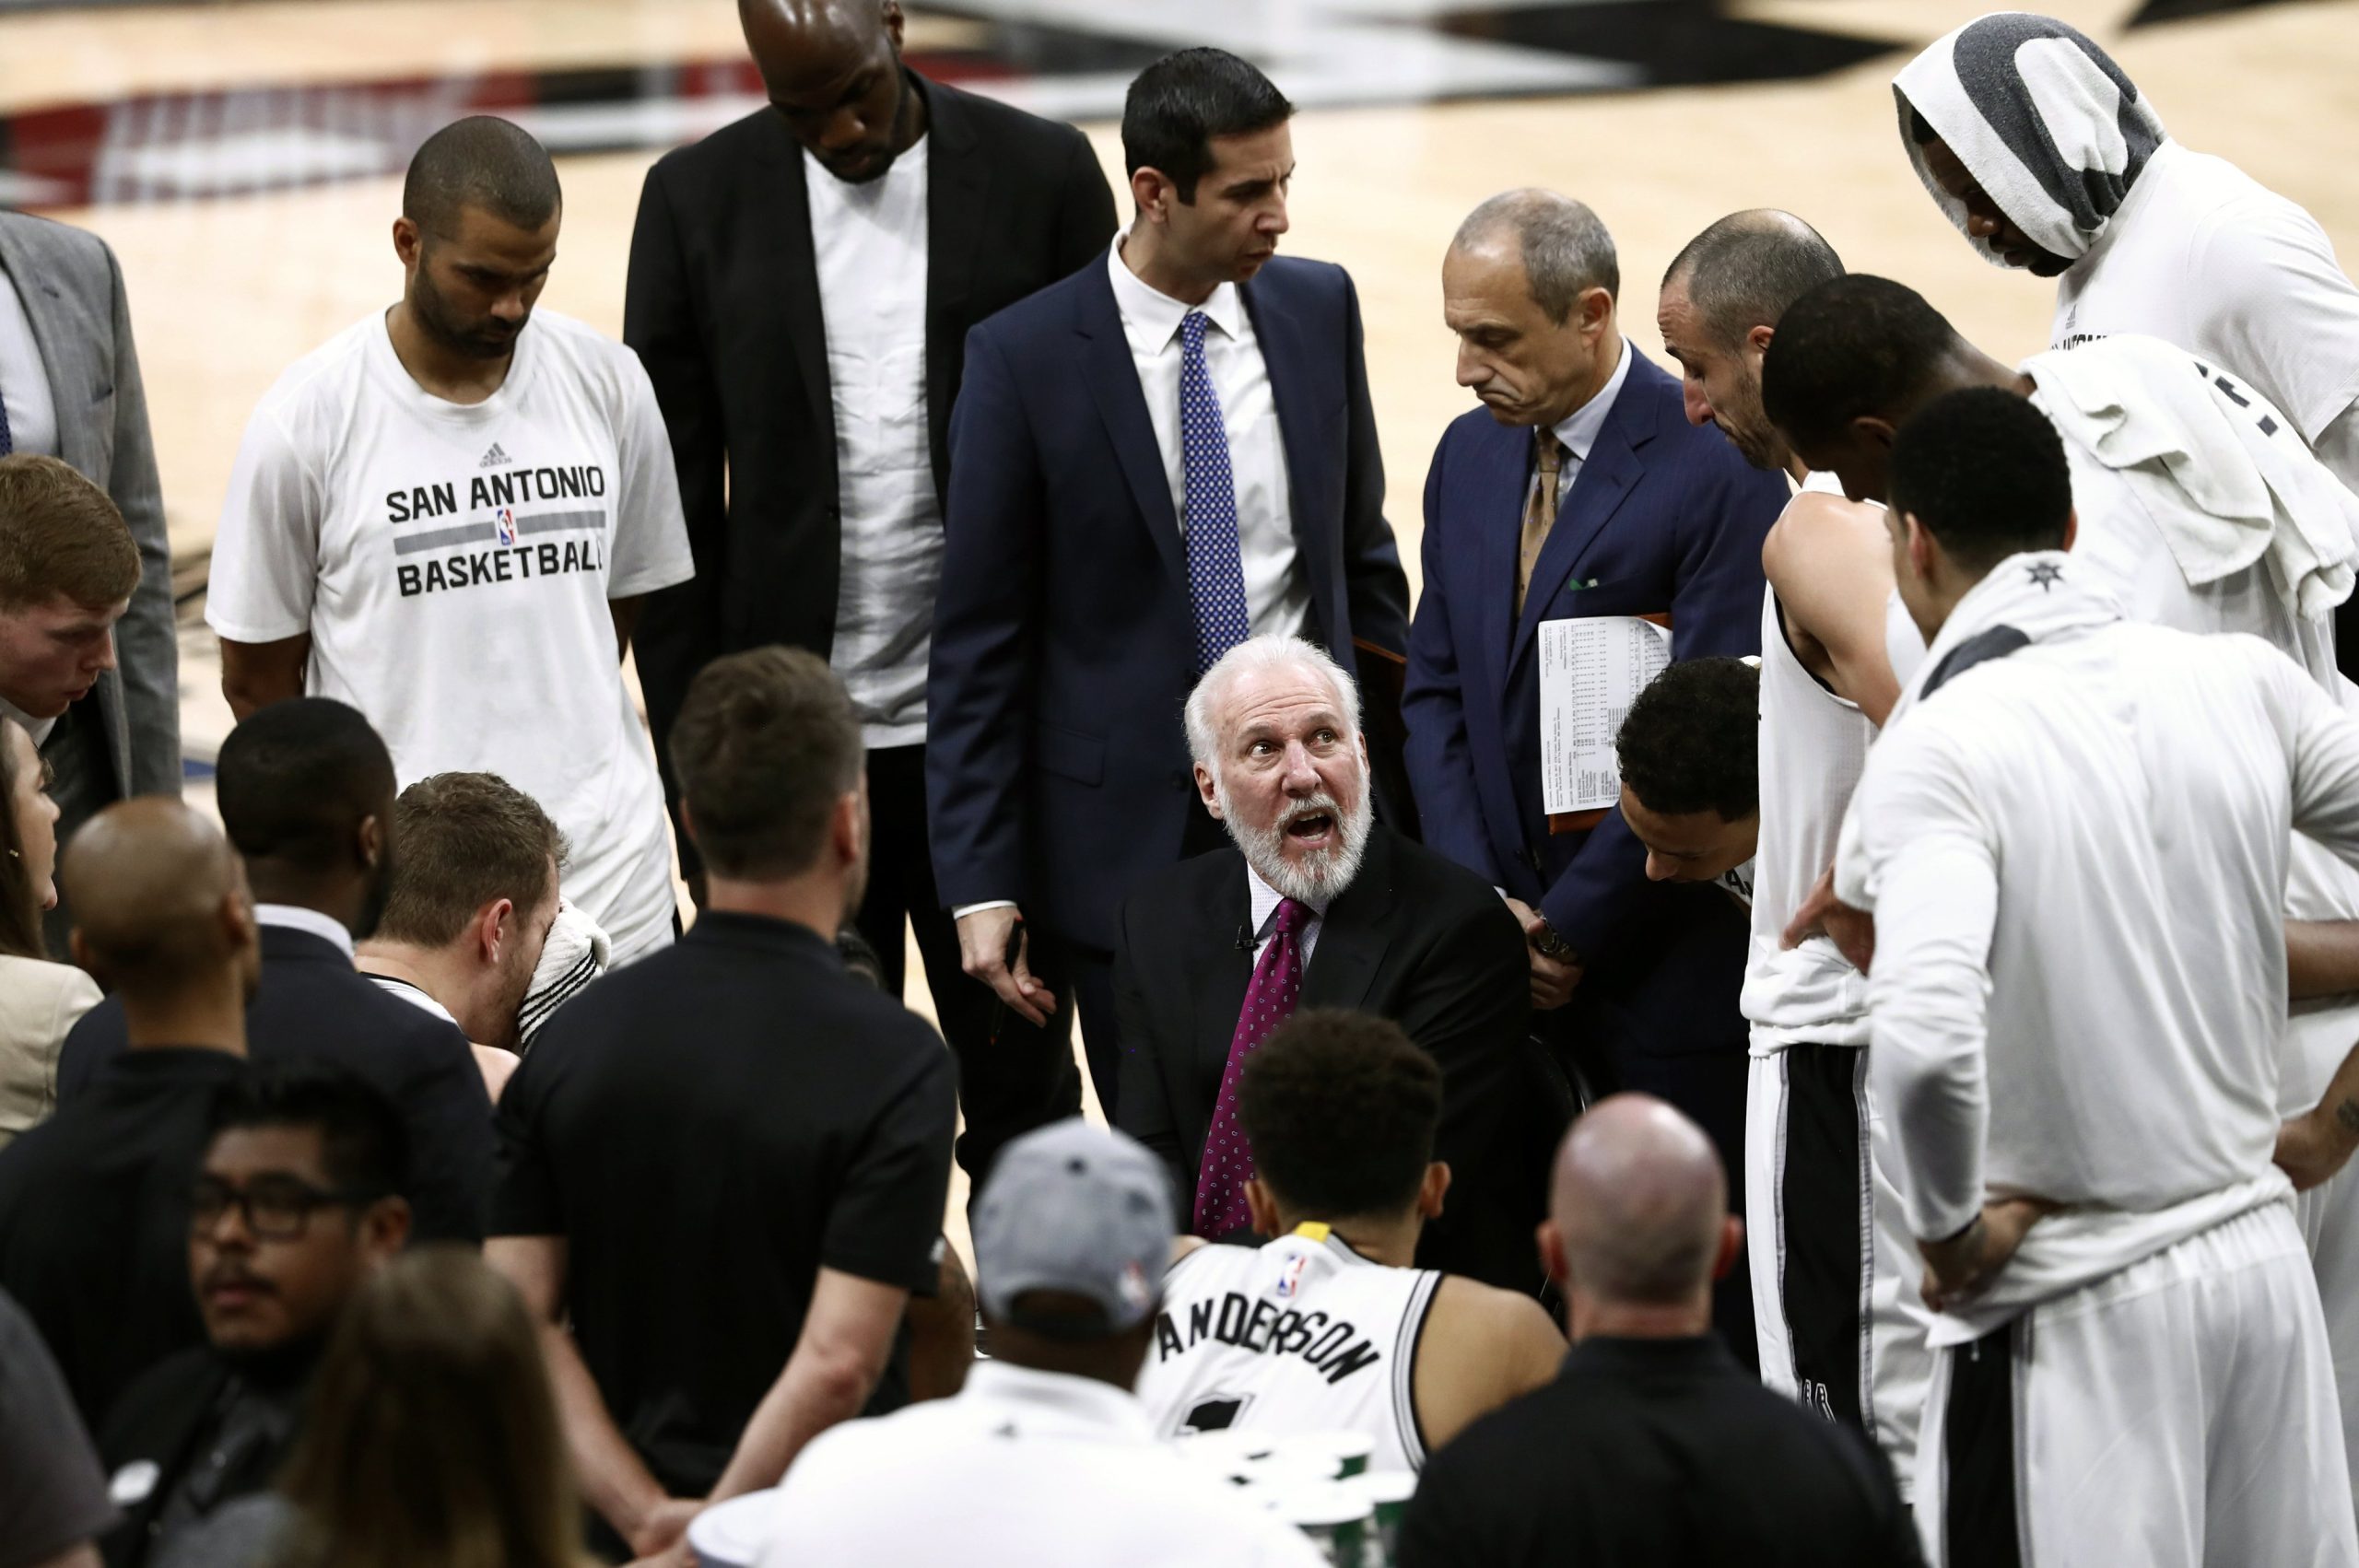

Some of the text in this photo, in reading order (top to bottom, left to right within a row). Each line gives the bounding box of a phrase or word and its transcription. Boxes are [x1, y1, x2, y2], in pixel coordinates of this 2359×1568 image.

[386, 466, 605, 523] SAN ANTONIO
[1156, 1292, 1380, 1385] ANDERSON
